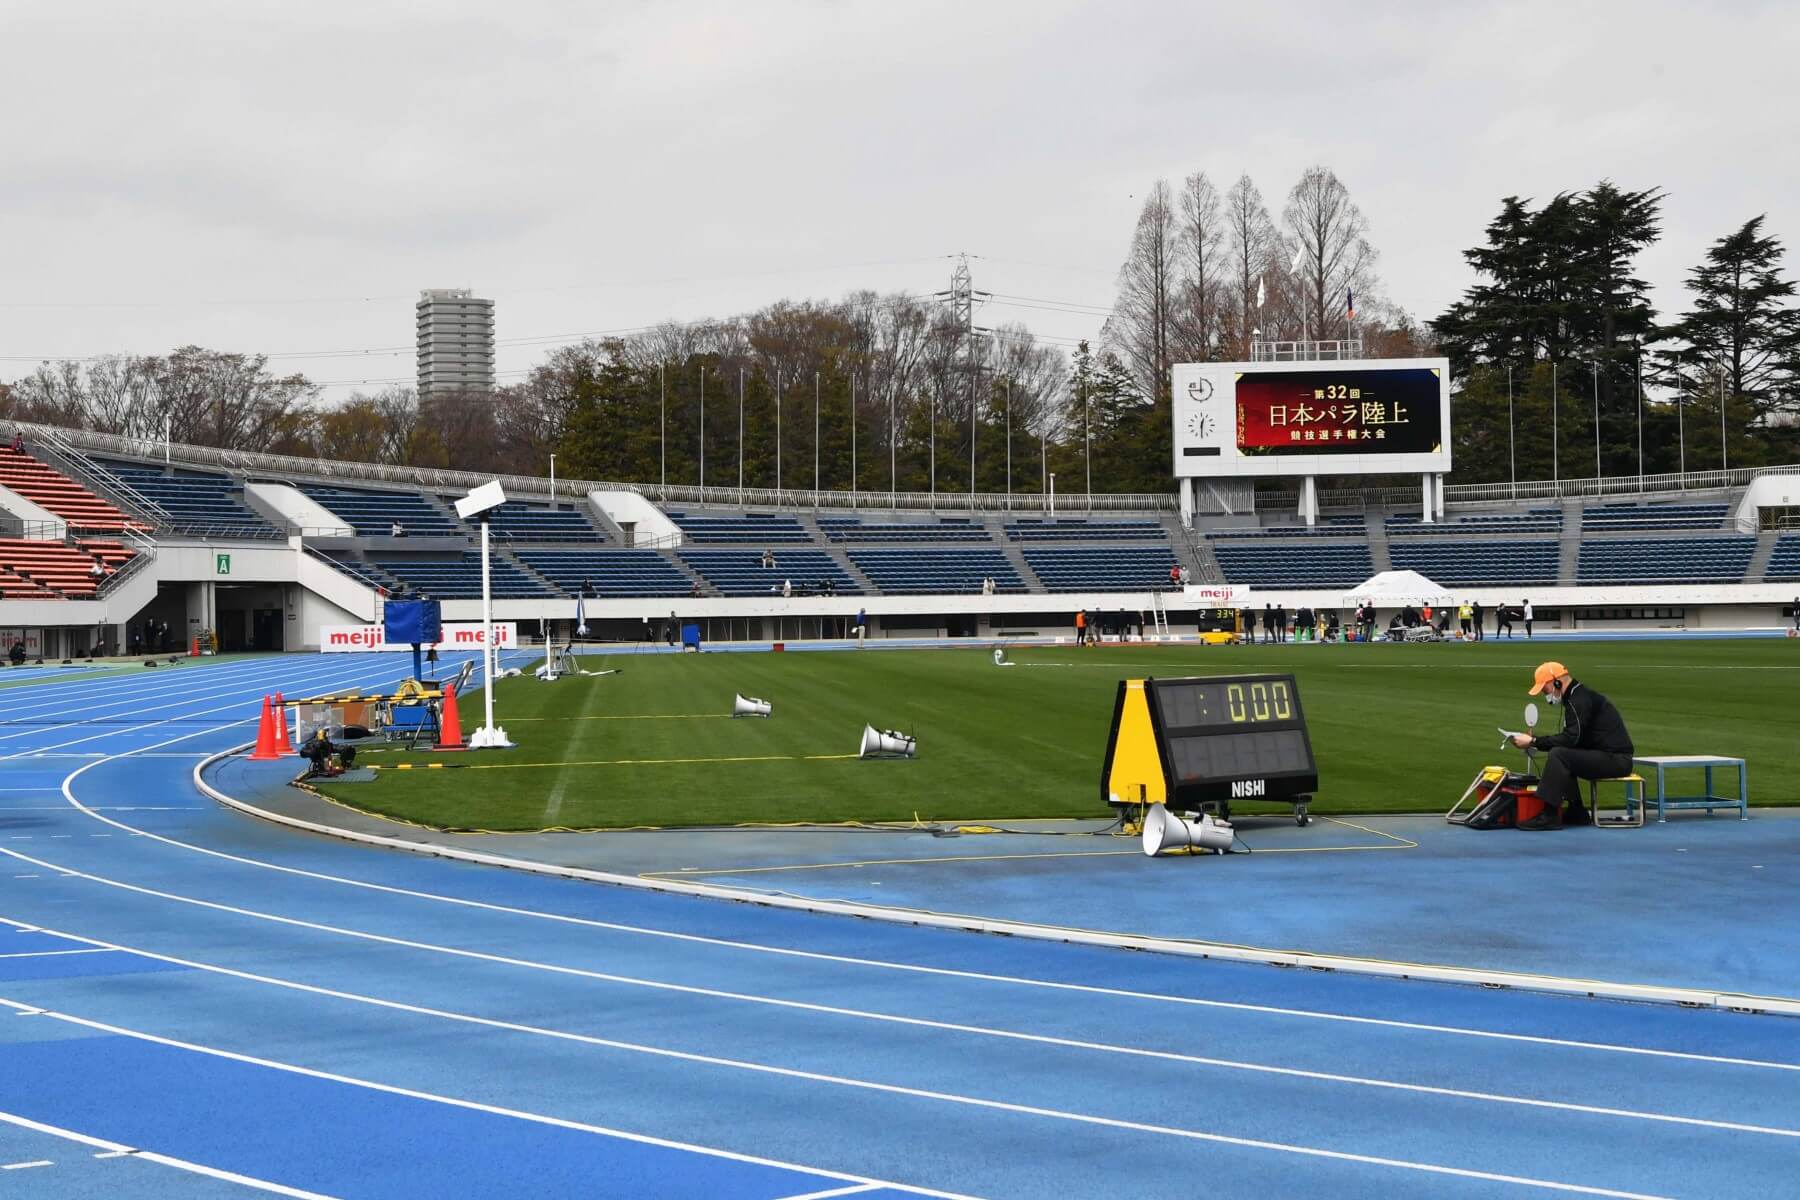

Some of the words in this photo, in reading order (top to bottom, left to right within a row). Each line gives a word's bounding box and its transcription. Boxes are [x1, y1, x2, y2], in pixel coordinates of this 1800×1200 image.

[1269, 401, 1410, 427] 日本パラ陸上
[1290, 428, 1387, 441] 競技選手権大会
[218, 559, 228, 573] A
[1200, 586, 1233, 600] meiji
[1199, 609, 1206, 619] 2
[330, 627, 382, 648] meiji
[455, 626, 507, 646] meji
[1231, 779, 1266, 798] NISHI
